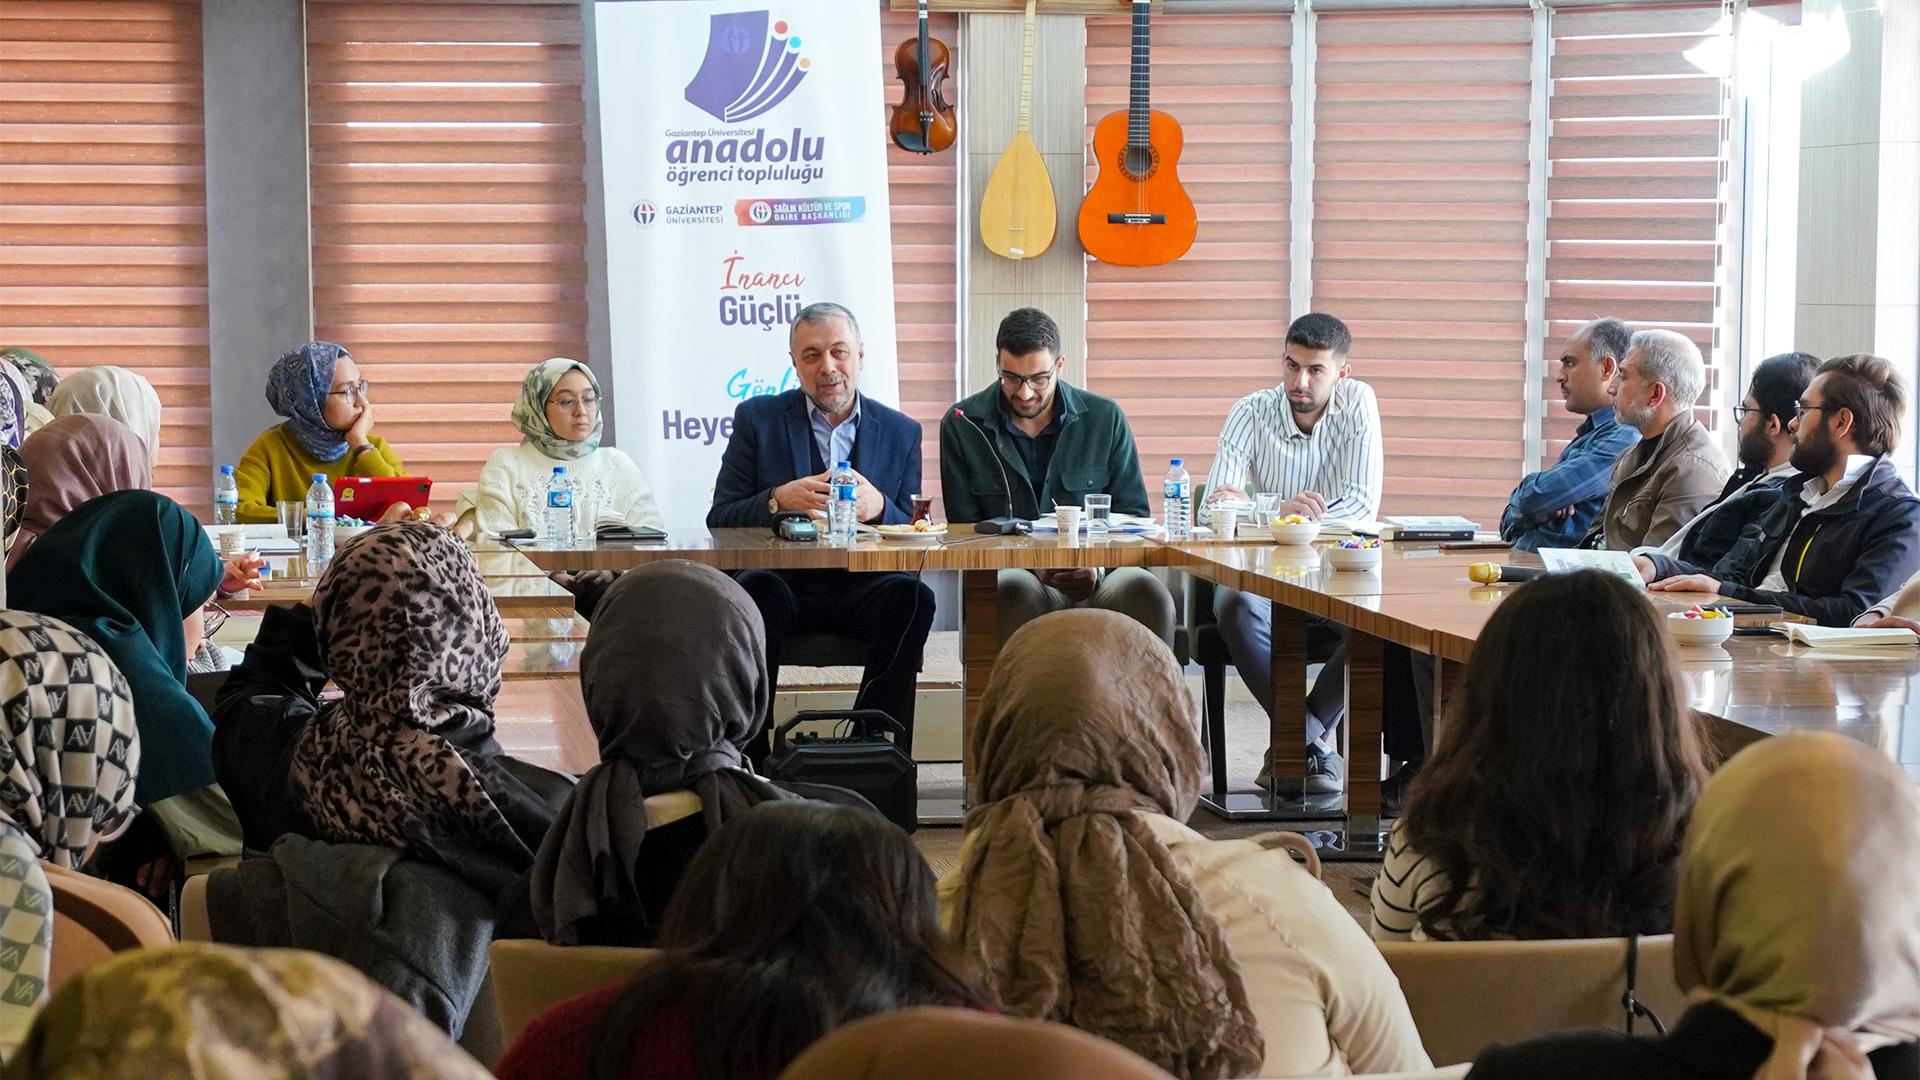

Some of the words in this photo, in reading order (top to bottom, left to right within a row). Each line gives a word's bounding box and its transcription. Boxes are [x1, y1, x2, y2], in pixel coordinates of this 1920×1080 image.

[665, 129, 707, 138] Gaziantep
[708, 127, 755, 137] Üniversitesi
[665, 128, 825, 164] anadolu
[666, 166, 734, 187] öğrenci
[737, 164, 824, 185] topluluğu
[665, 204, 723, 215] GAZİANTEP
[666, 214, 723, 224] ÜNİVERSİTESİ
[720, 249, 806, 290] İnancı
[719, 294, 802, 332] Güçlü
[662, 409, 735, 446] Heye
